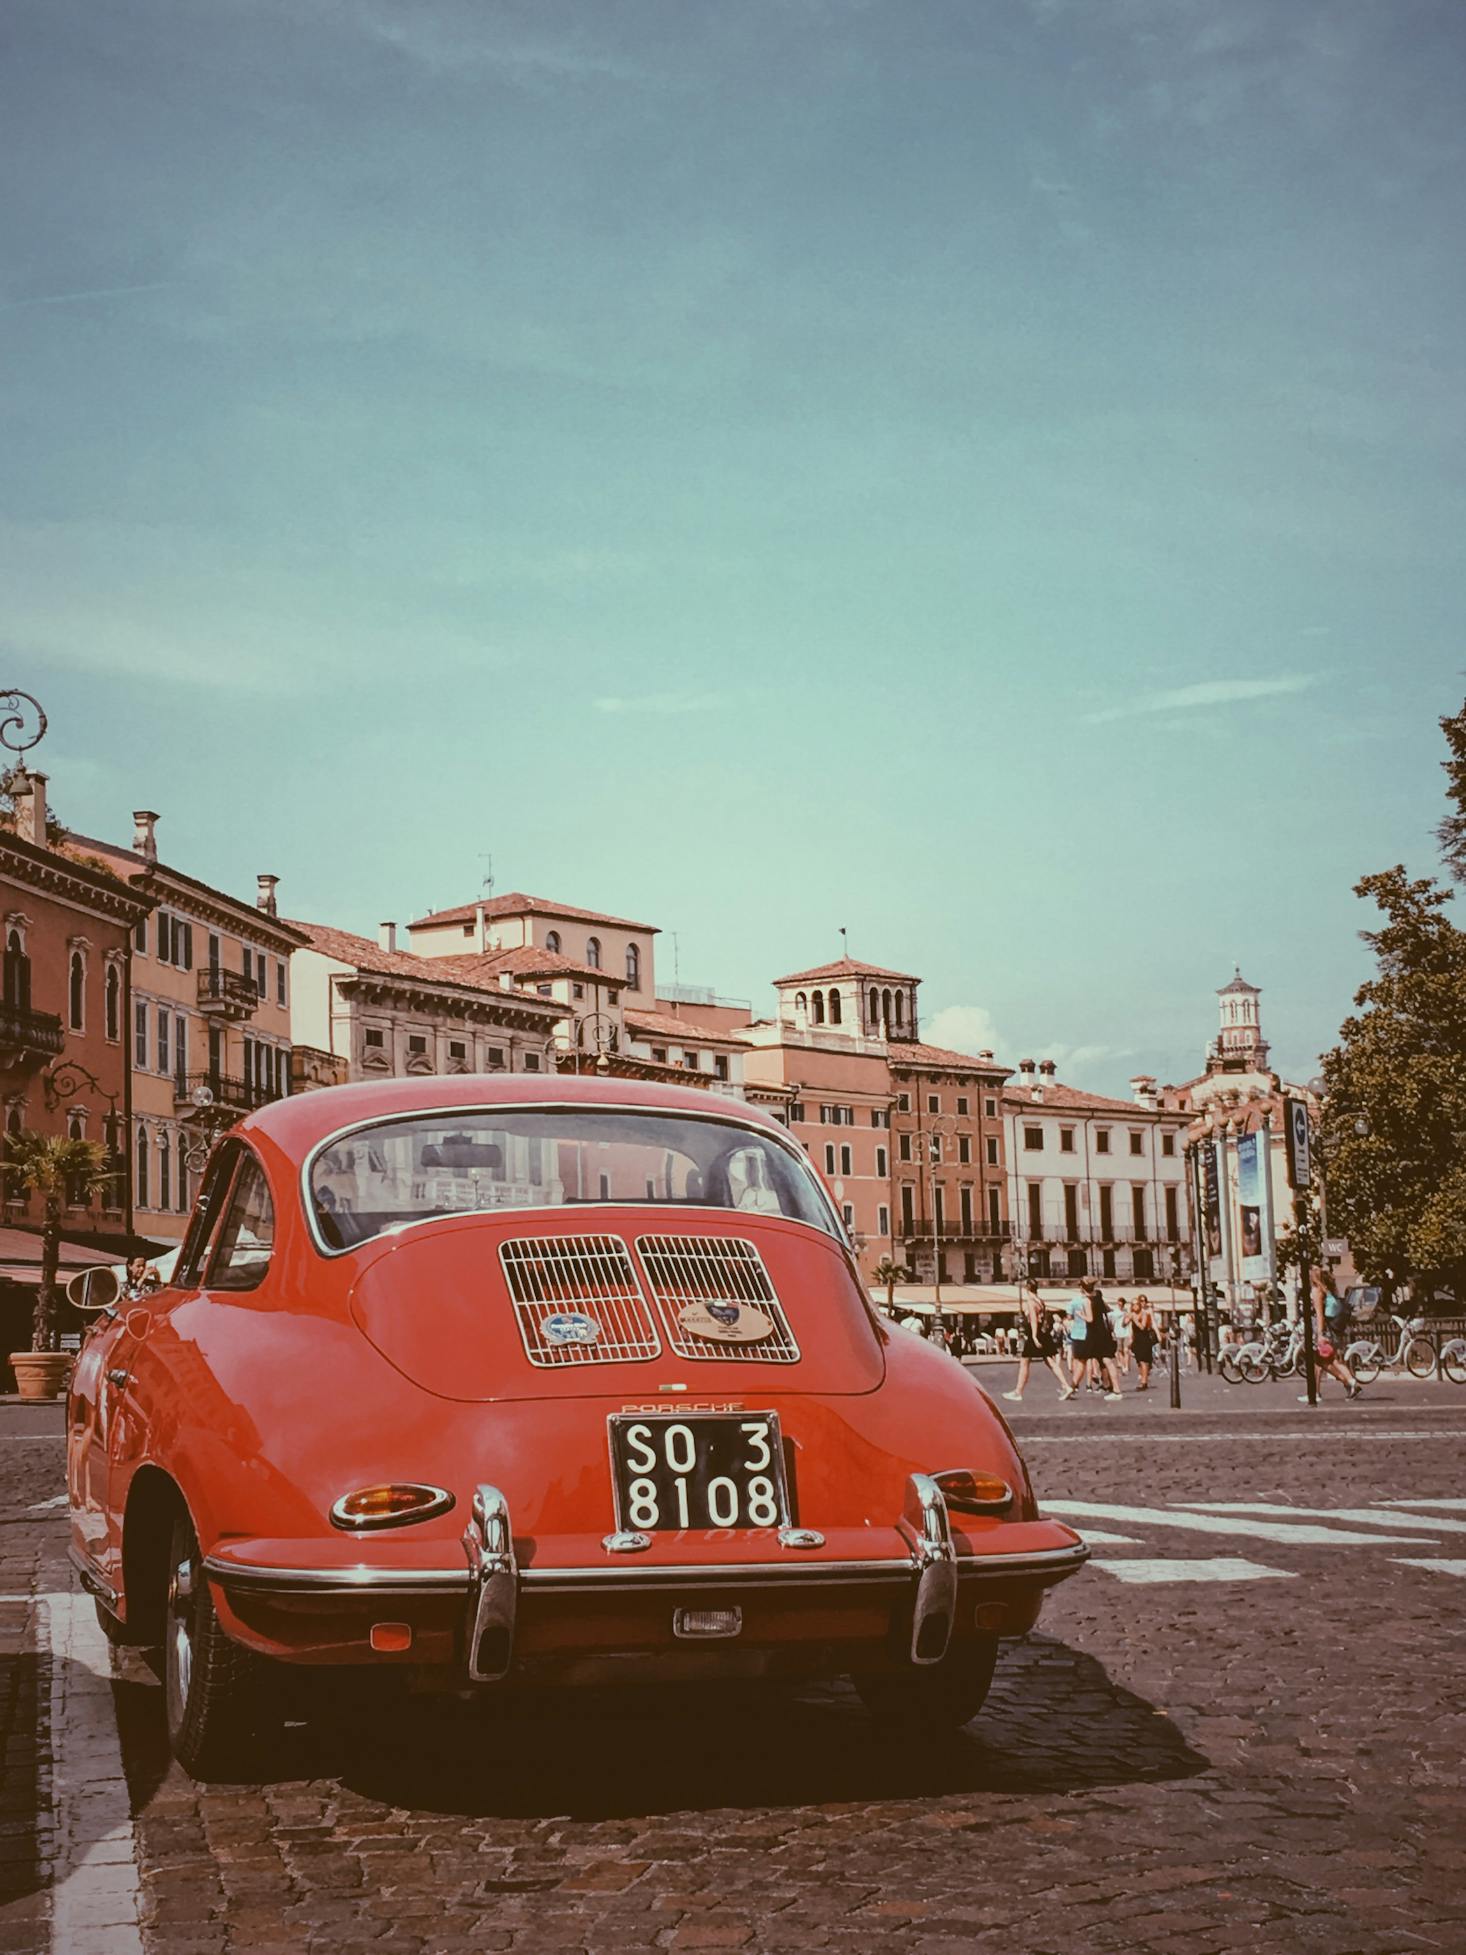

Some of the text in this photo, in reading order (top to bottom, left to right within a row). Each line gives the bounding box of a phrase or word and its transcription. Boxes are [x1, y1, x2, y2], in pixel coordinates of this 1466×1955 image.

[1328, 1243, 1343, 1252] WC
[621, 1402, 743, 1414] PORSCHE
[627, 1422, 770, 1474] SO 3
[629, 1475, 777, 1529] 8108
